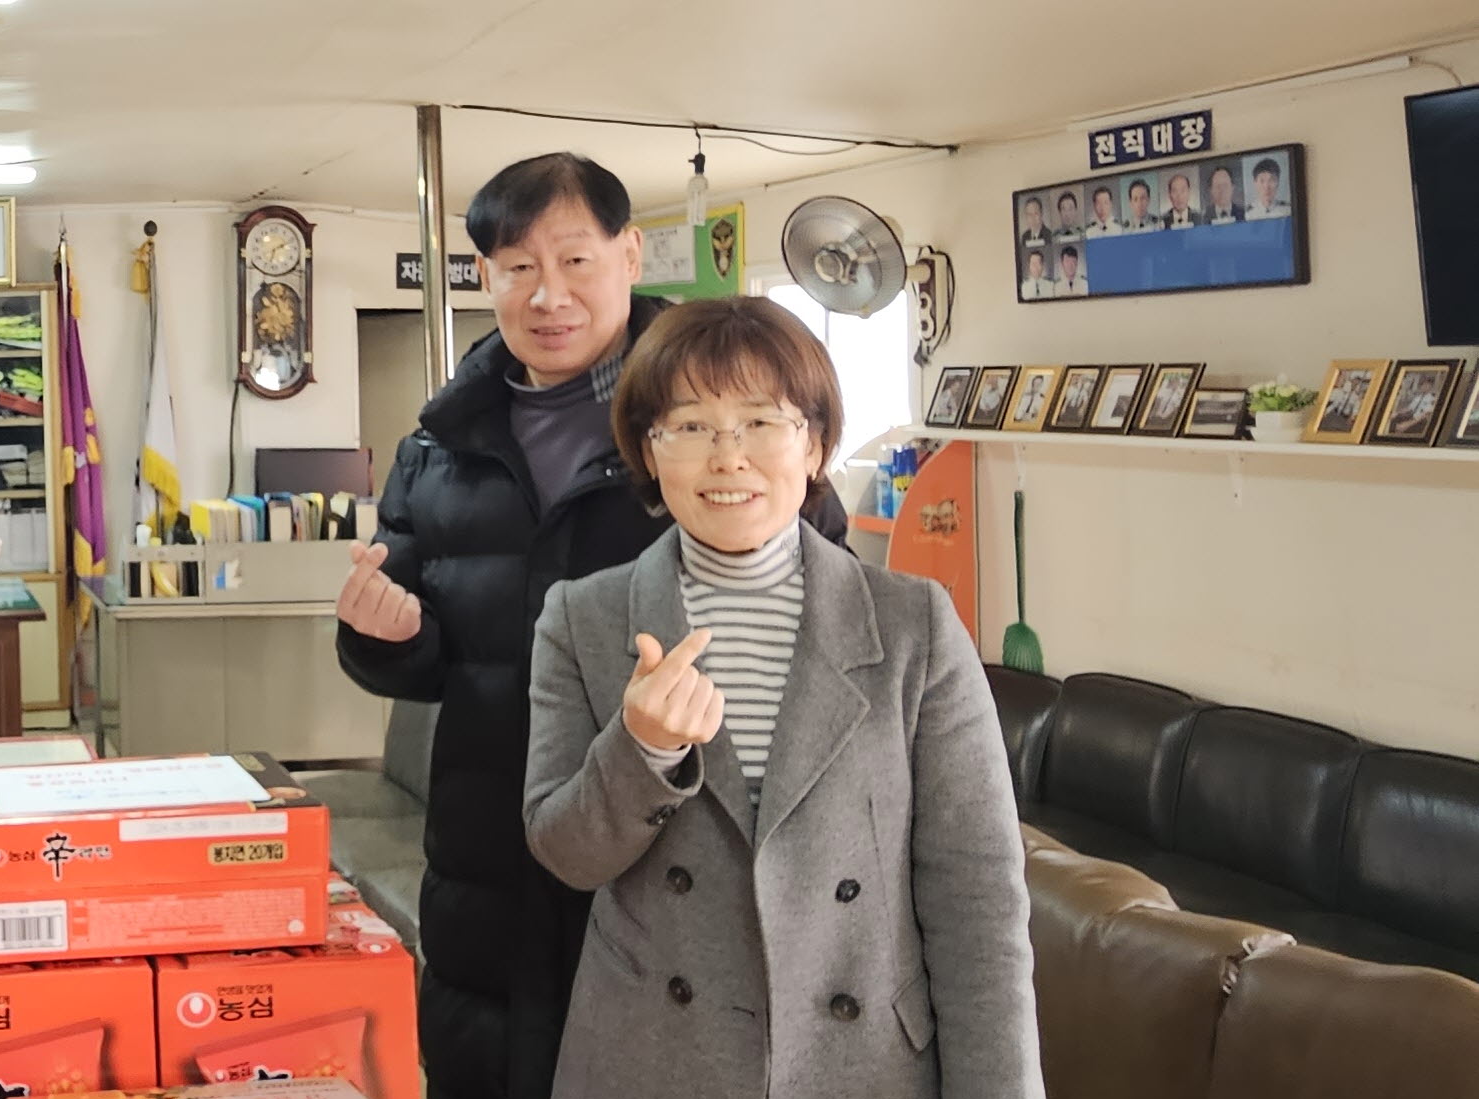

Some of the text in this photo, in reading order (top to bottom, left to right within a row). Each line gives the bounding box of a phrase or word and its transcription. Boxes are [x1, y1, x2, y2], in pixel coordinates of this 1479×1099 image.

[214, 843, 284, 863] 봉지면 20개입
[217, 996, 274, 1021] 농심
